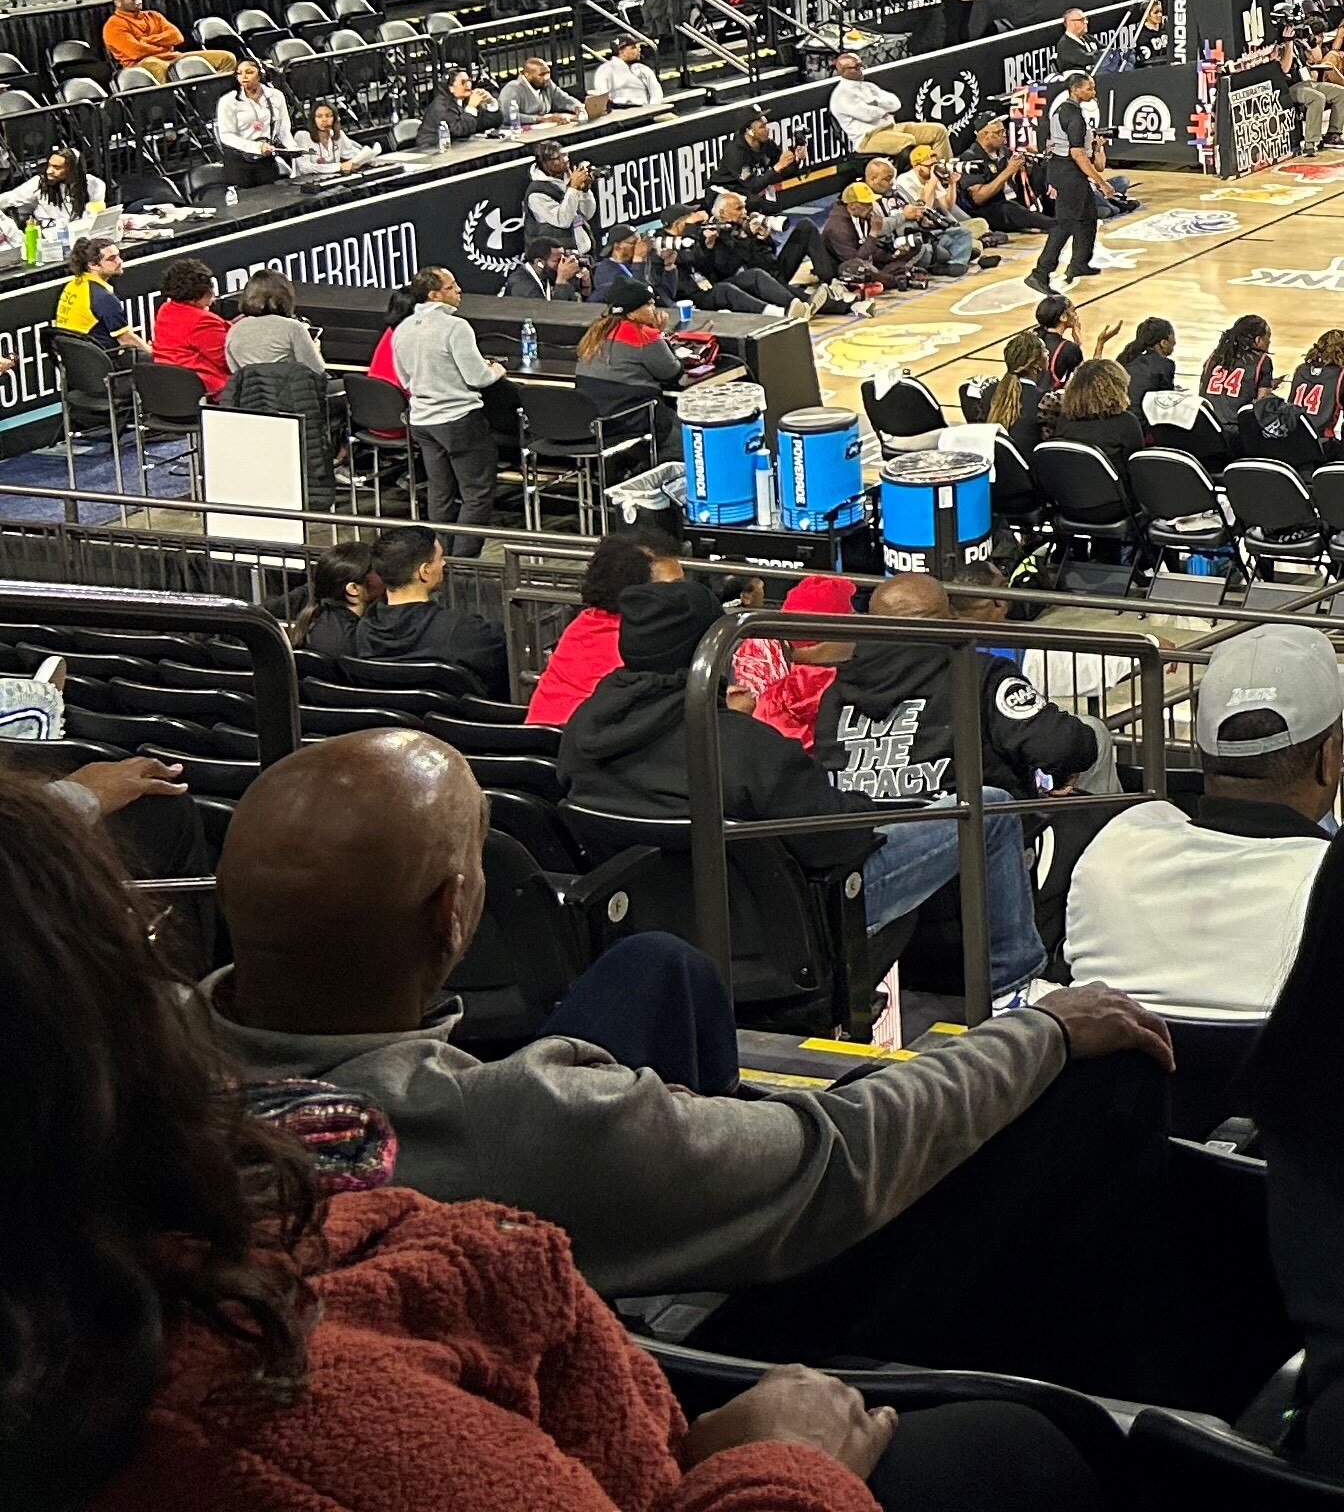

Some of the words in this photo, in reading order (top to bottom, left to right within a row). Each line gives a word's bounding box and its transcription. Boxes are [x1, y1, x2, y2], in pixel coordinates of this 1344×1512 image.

[1135, 111, 1160, 132] 50
[1232, 89, 1284, 125] BLACK
[1234, 106, 1296, 151] HISTORY
[1236, 133, 1293, 173] MONTH
[1205, 365, 1246, 398] 24
[1293, 381, 1323, 416] 14
[692, 432, 706, 498] POWERADE
[792, 434, 805, 503] POWERADE
[836, 698, 927, 742] LIVE
[843, 734, 915, 772] THE
